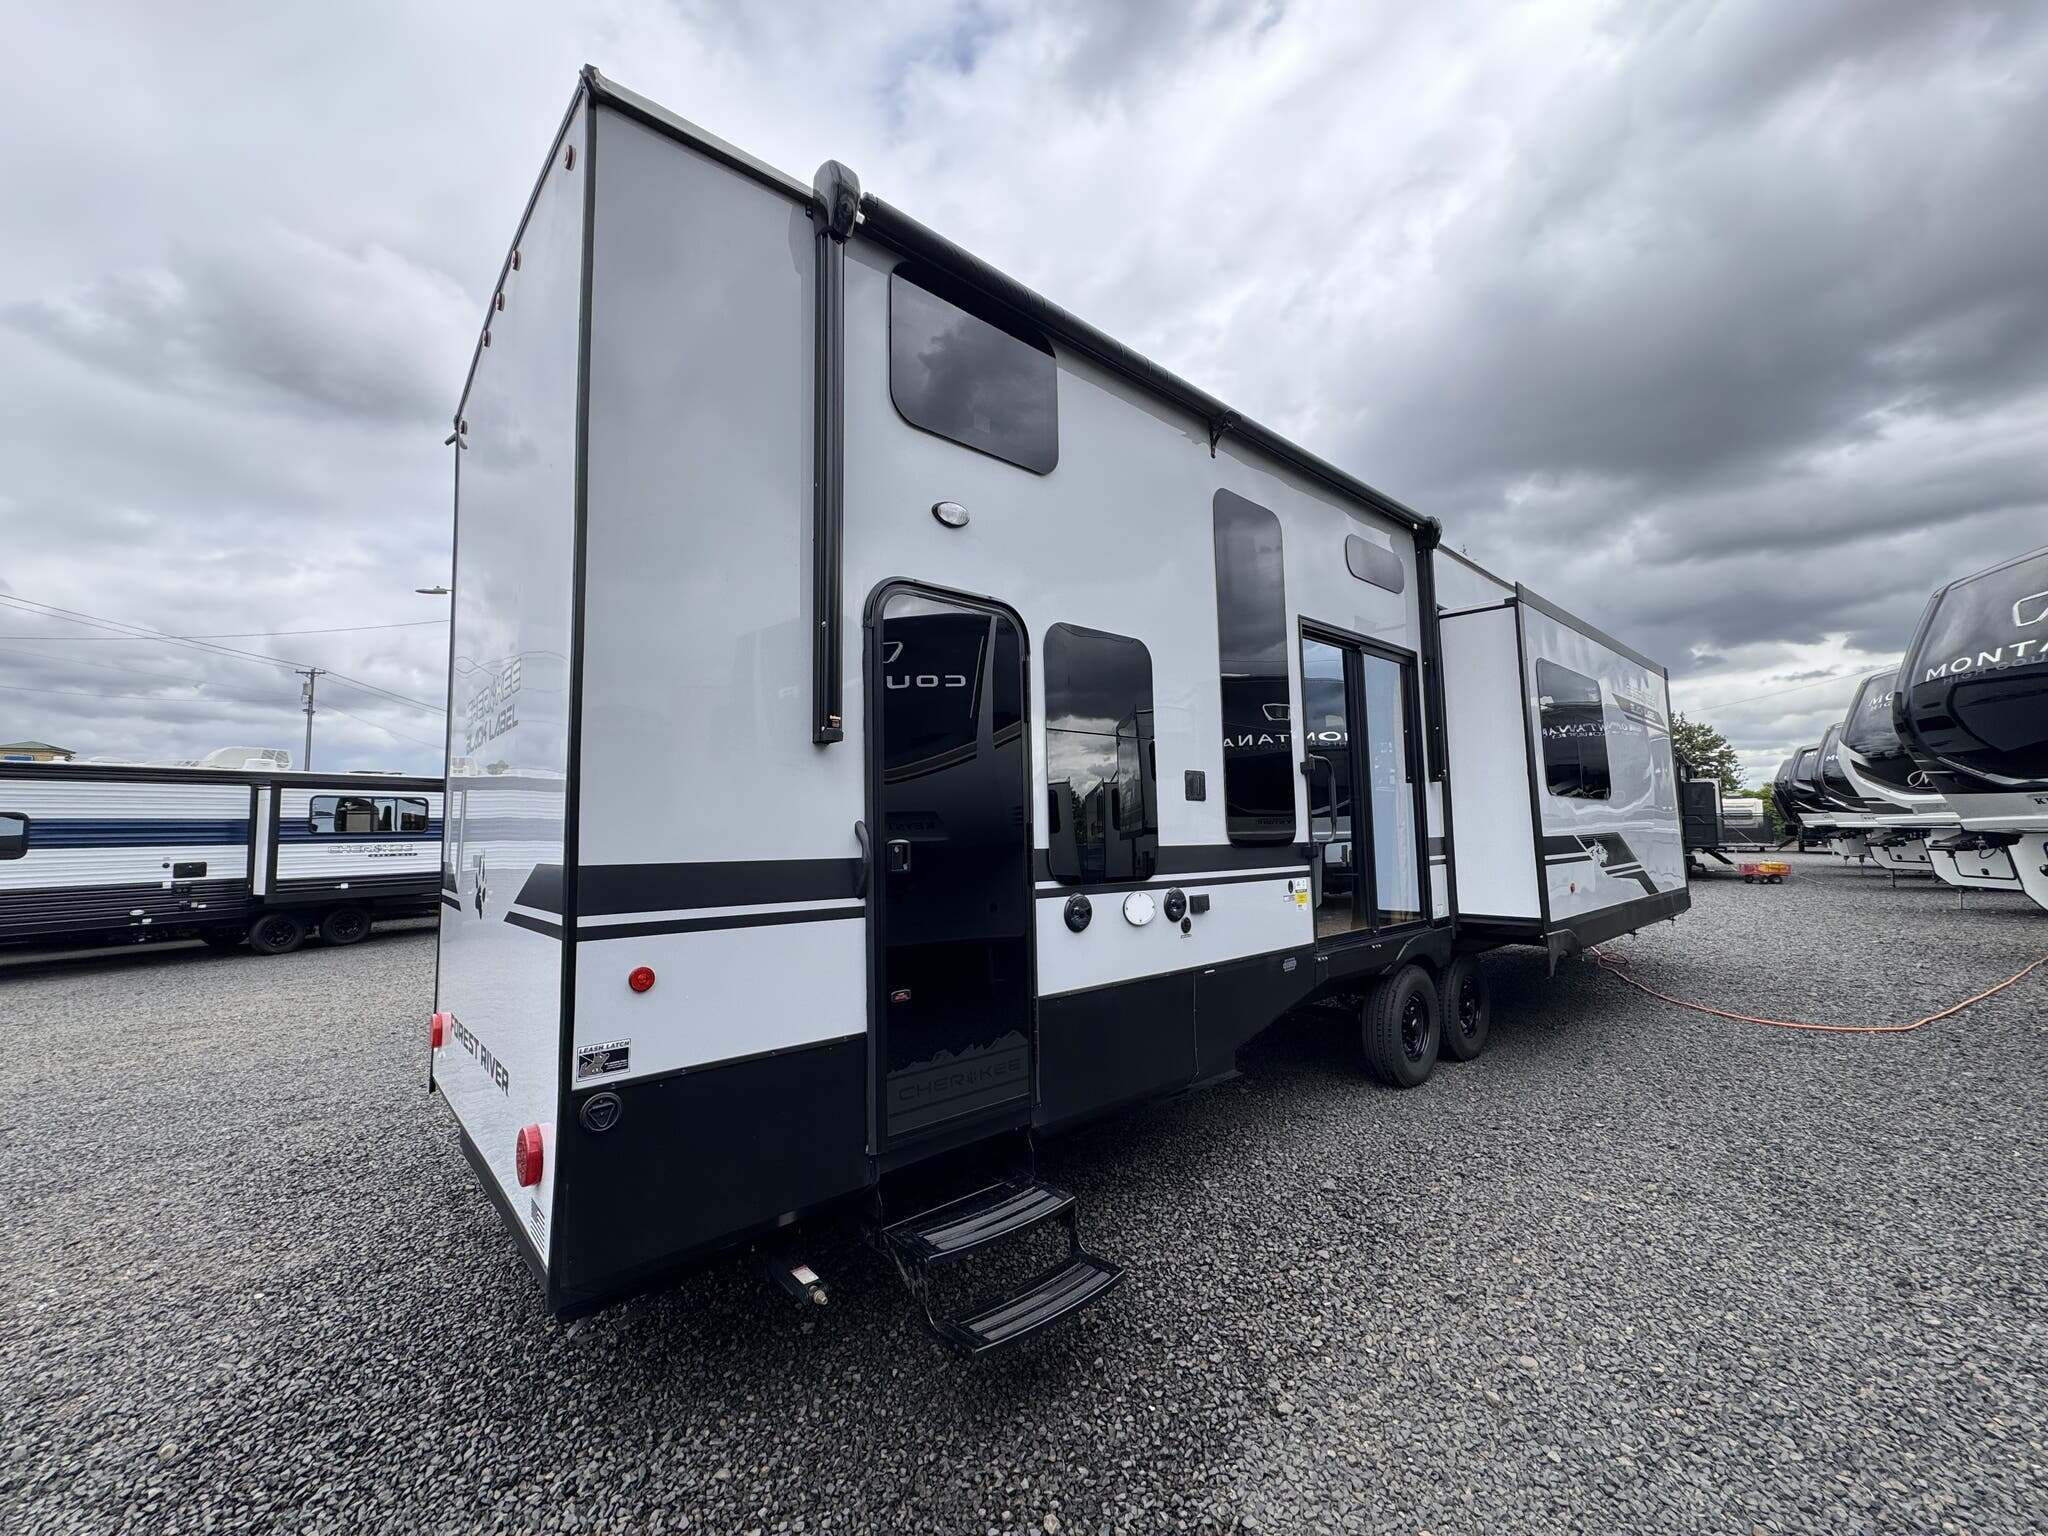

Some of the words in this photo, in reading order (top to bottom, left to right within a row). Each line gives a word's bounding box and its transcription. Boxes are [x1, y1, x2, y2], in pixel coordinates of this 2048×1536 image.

[450, 1012, 480, 1060] FOREST
[480, 1043, 509, 1097] RIVER
[579, 1045, 604, 1055] LEASH
[606, 1040, 630, 1051] LATCH
